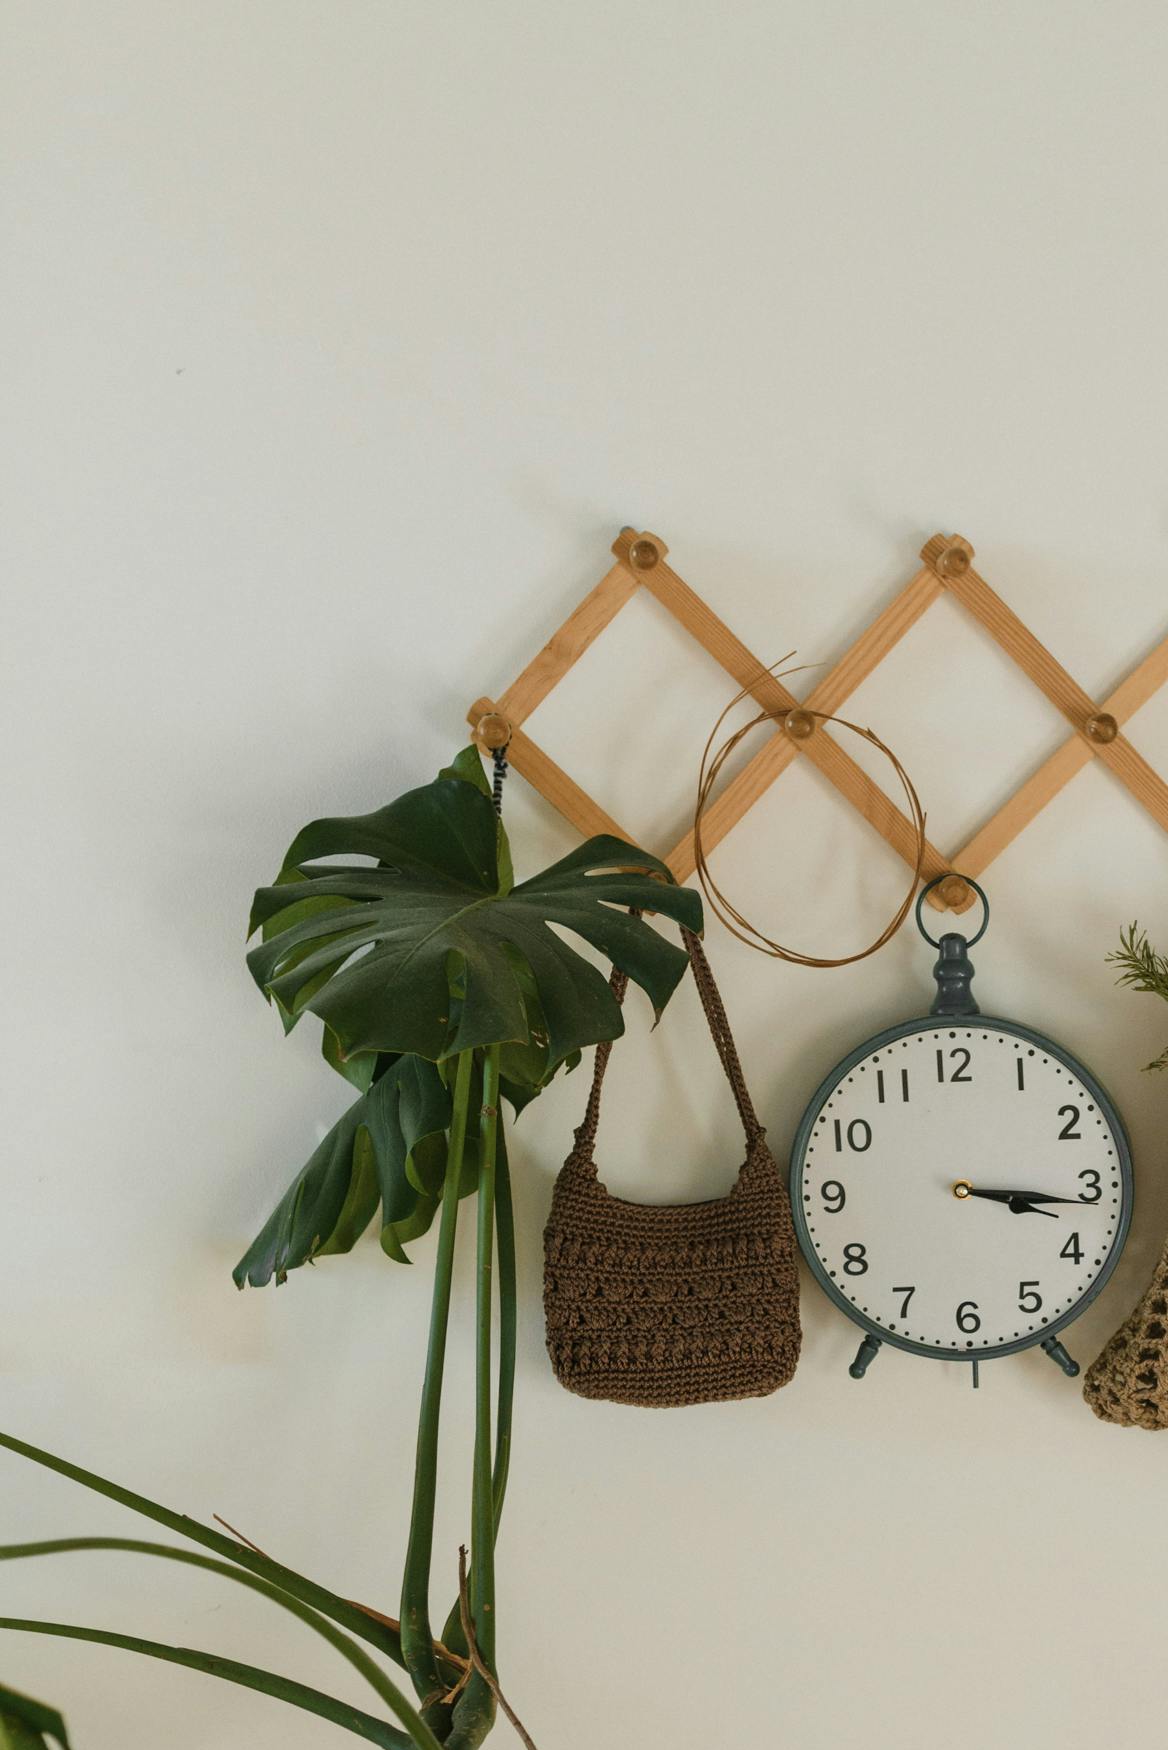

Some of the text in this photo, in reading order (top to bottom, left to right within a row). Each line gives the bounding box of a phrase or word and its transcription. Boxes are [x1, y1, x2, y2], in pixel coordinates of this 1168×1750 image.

[936, 1047, 973, 1083] 12
[1016, 1057, 1025, 1091] 1
[876, 1068, 910, 1104] 11
[833, 1118, 873, 1153] 10
[1057, 1104, 1082, 1141] 2
[820, 1180, 847, 1214] 9
[1077, 1169, 1103, 1203] 3
[842, 1242, 869, 1276] 8
[1059, 1231, 1085, 1265] 4
[892, 1286, 917, 1319] 7
[1018, 1280, 1043, 1314] 5
[955, 1301, 982, 1334] 6
